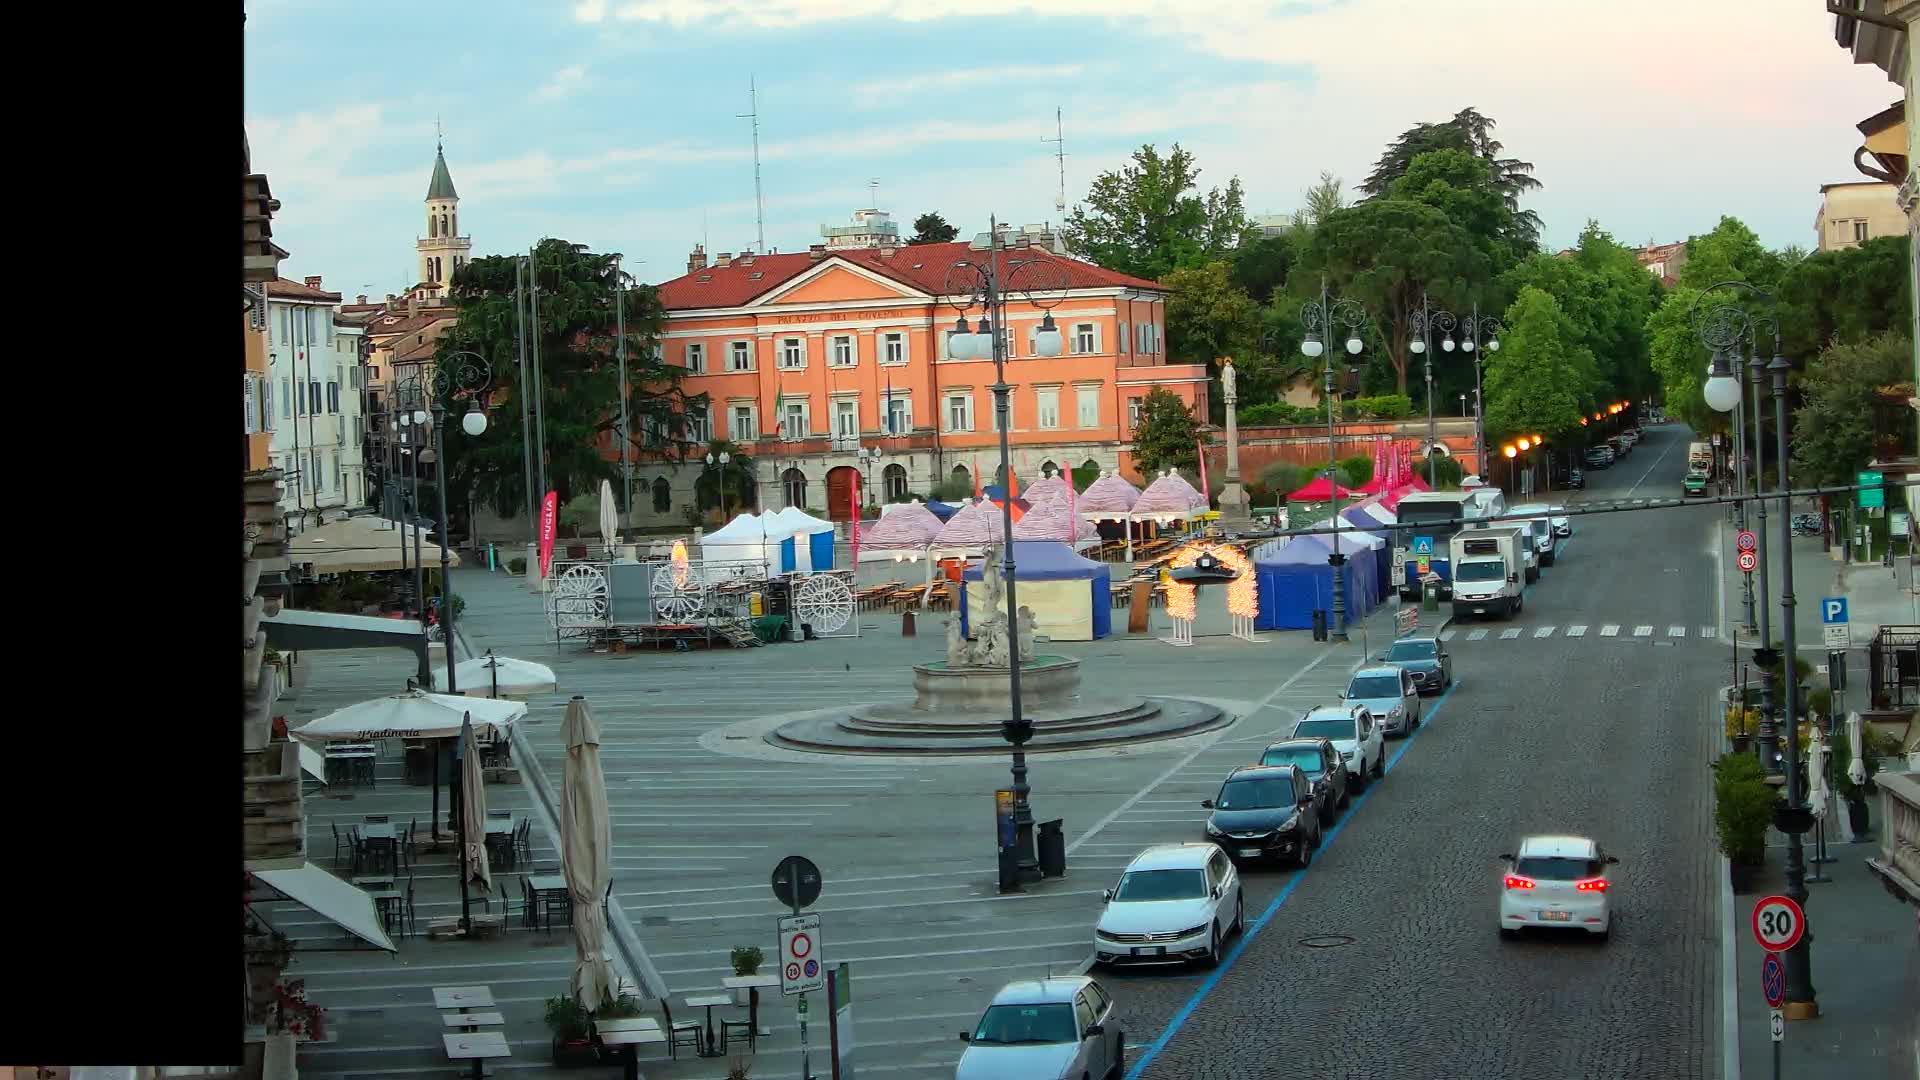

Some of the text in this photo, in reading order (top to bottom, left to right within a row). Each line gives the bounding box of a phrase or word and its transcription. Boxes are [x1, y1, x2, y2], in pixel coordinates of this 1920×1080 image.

[544, 499, 553, 540] PUGLIA
[1742, 556, 1753, 566] 20
[1828, 601, 1842, 621] P
[358, 728, 420, 739] Piadineria
[1762, 910, 1792, 937] 30
